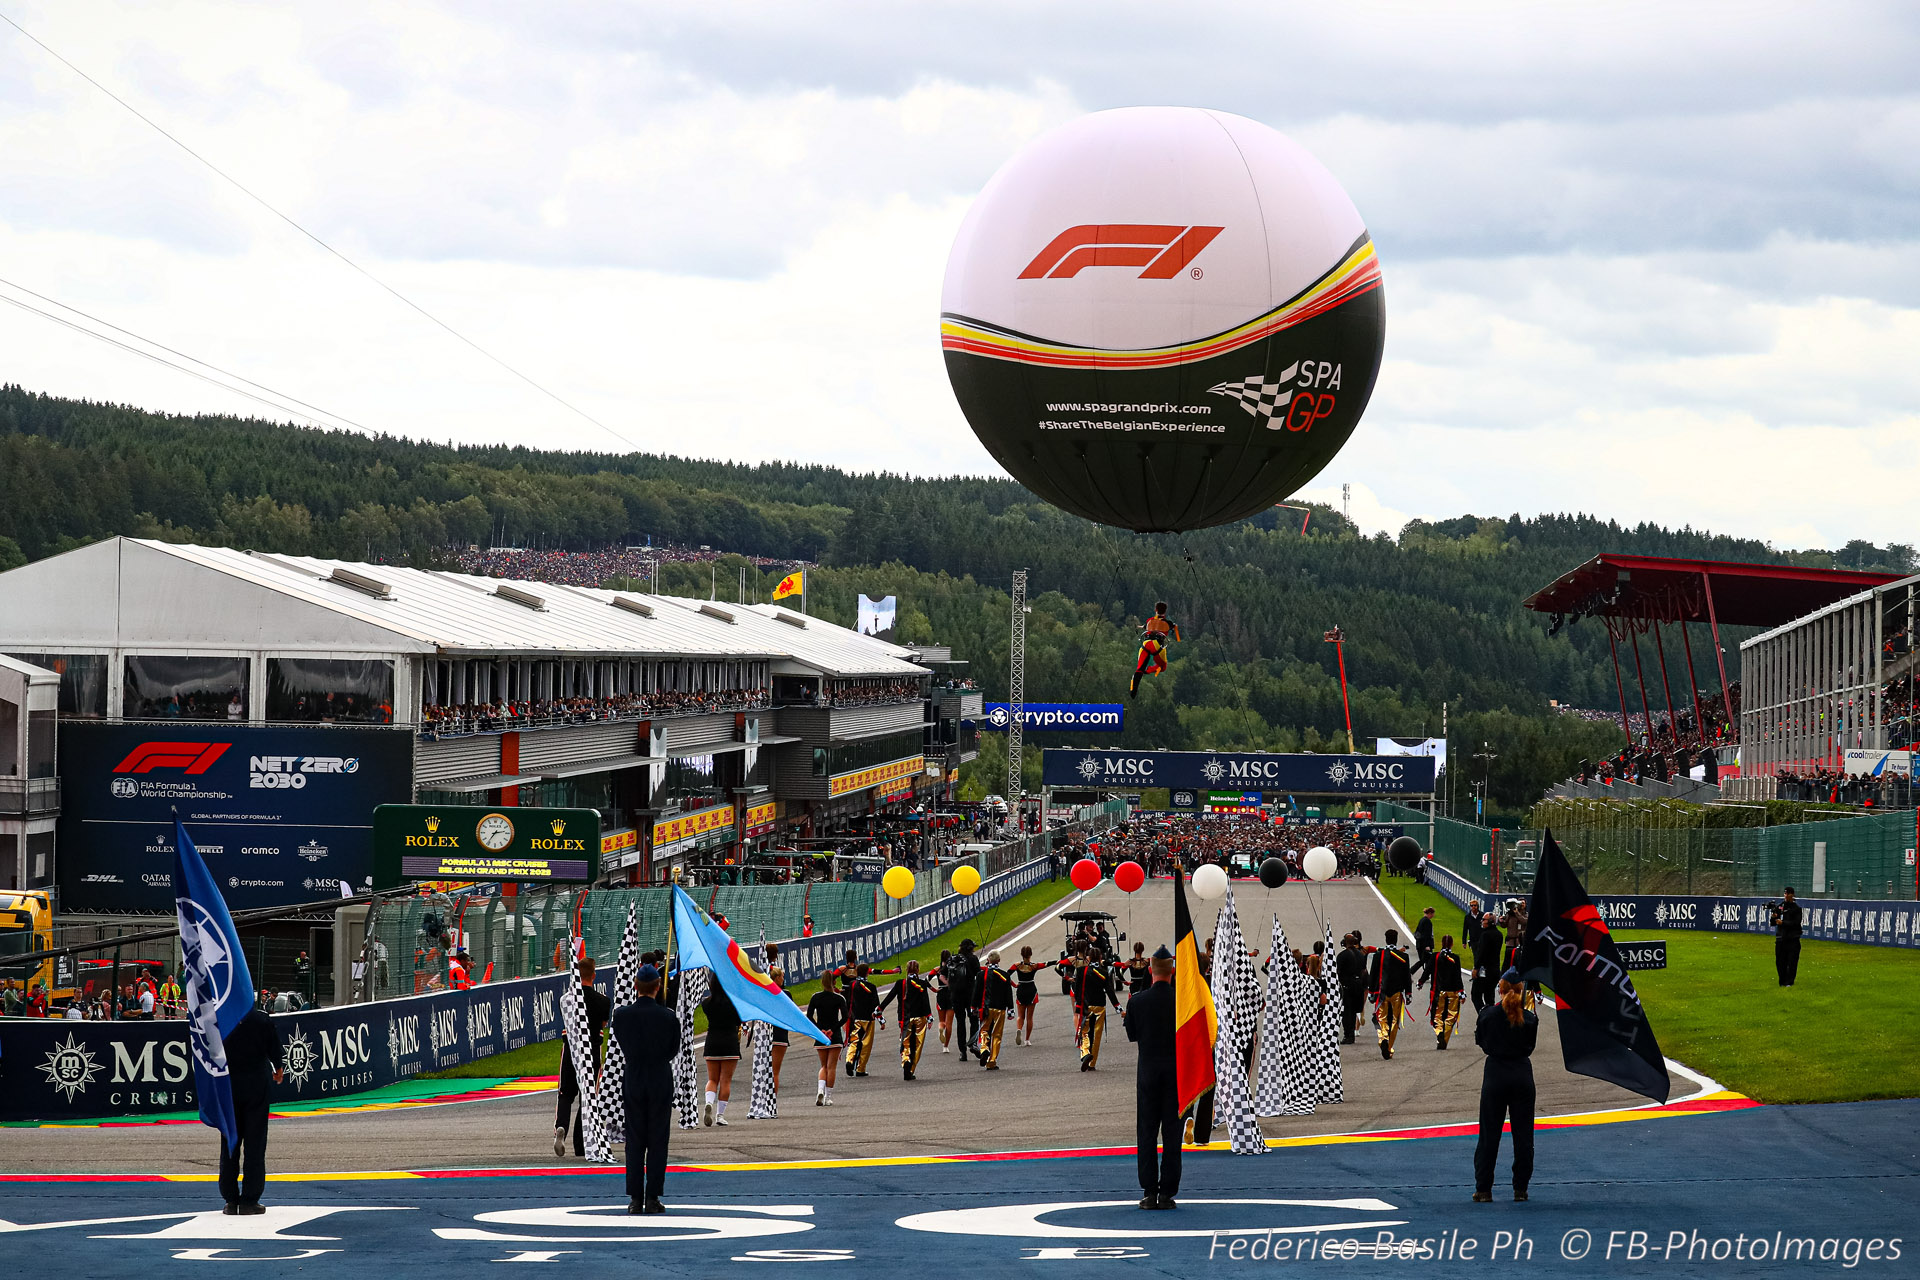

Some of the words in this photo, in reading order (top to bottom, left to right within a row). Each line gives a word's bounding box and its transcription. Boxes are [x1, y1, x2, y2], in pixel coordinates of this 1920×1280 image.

[1297, 360, 1342, 391] SPA
[1046, 402, 1211, 415] www.spagrandprix.com
[1286, 392, 1335, 432] GP
[1038, 420, 1226, 433] #ShareTheBelgianExperience
[1014, 709, 1119, 726] crypto.com
[1104, 758, 1154, 776] MSC
[1229, 760, 1279, 778] MSC
[1354, 763, 1404, 780] MSC
[141, 782, 154, 790] FIA
[156, 782, 191, 790] Formula
[250, 773, 307, 789] 2030
[1104, 777, 1154, 785] CRUISES
[140, 790, 166, 798] World
[167, 790, 227, 799] Championship
[405, 835, 460, 848] ROLEX
[531, 838, 585, 850] ROLEX
[196, 846, 224, 854] IRELLI
[241, 847, 280, 855] aramco
[442, 859, 485, 867] FORMULA
[864, 864, 881, 872] MSC
[85, 874, 119, 882] DHL
[141, 873, 171, 882] QATAR
[477, 867, 507, 875] GRAND
[240, 878, 284, 887] crypto.com
[315, 878, 339, 888] MSC
[1608, 902, 1636, 919] MSC
[1669, 903, 1697, 920] MSC
[1723, 904, 1741, 922] MSC
[1628, 948, 1665, 962] MSC
[507, 996, 525, 1032] MSC
[539, 990, 555, 1025] MSC
[438, 1008, 458, 1048] MSC
[474, 1001, 493, 1040] MSC
[398, 1015, 420, 1056] MSC
[319, 1022, 371, 1071] MSC
[110, 1041, 194, 1083] MS
[401, 1061, 422, 1076] CRUISES
[321, 1070, 373, 1092] CRUISES
[110, 1090, 193, 1105] CRUIS
